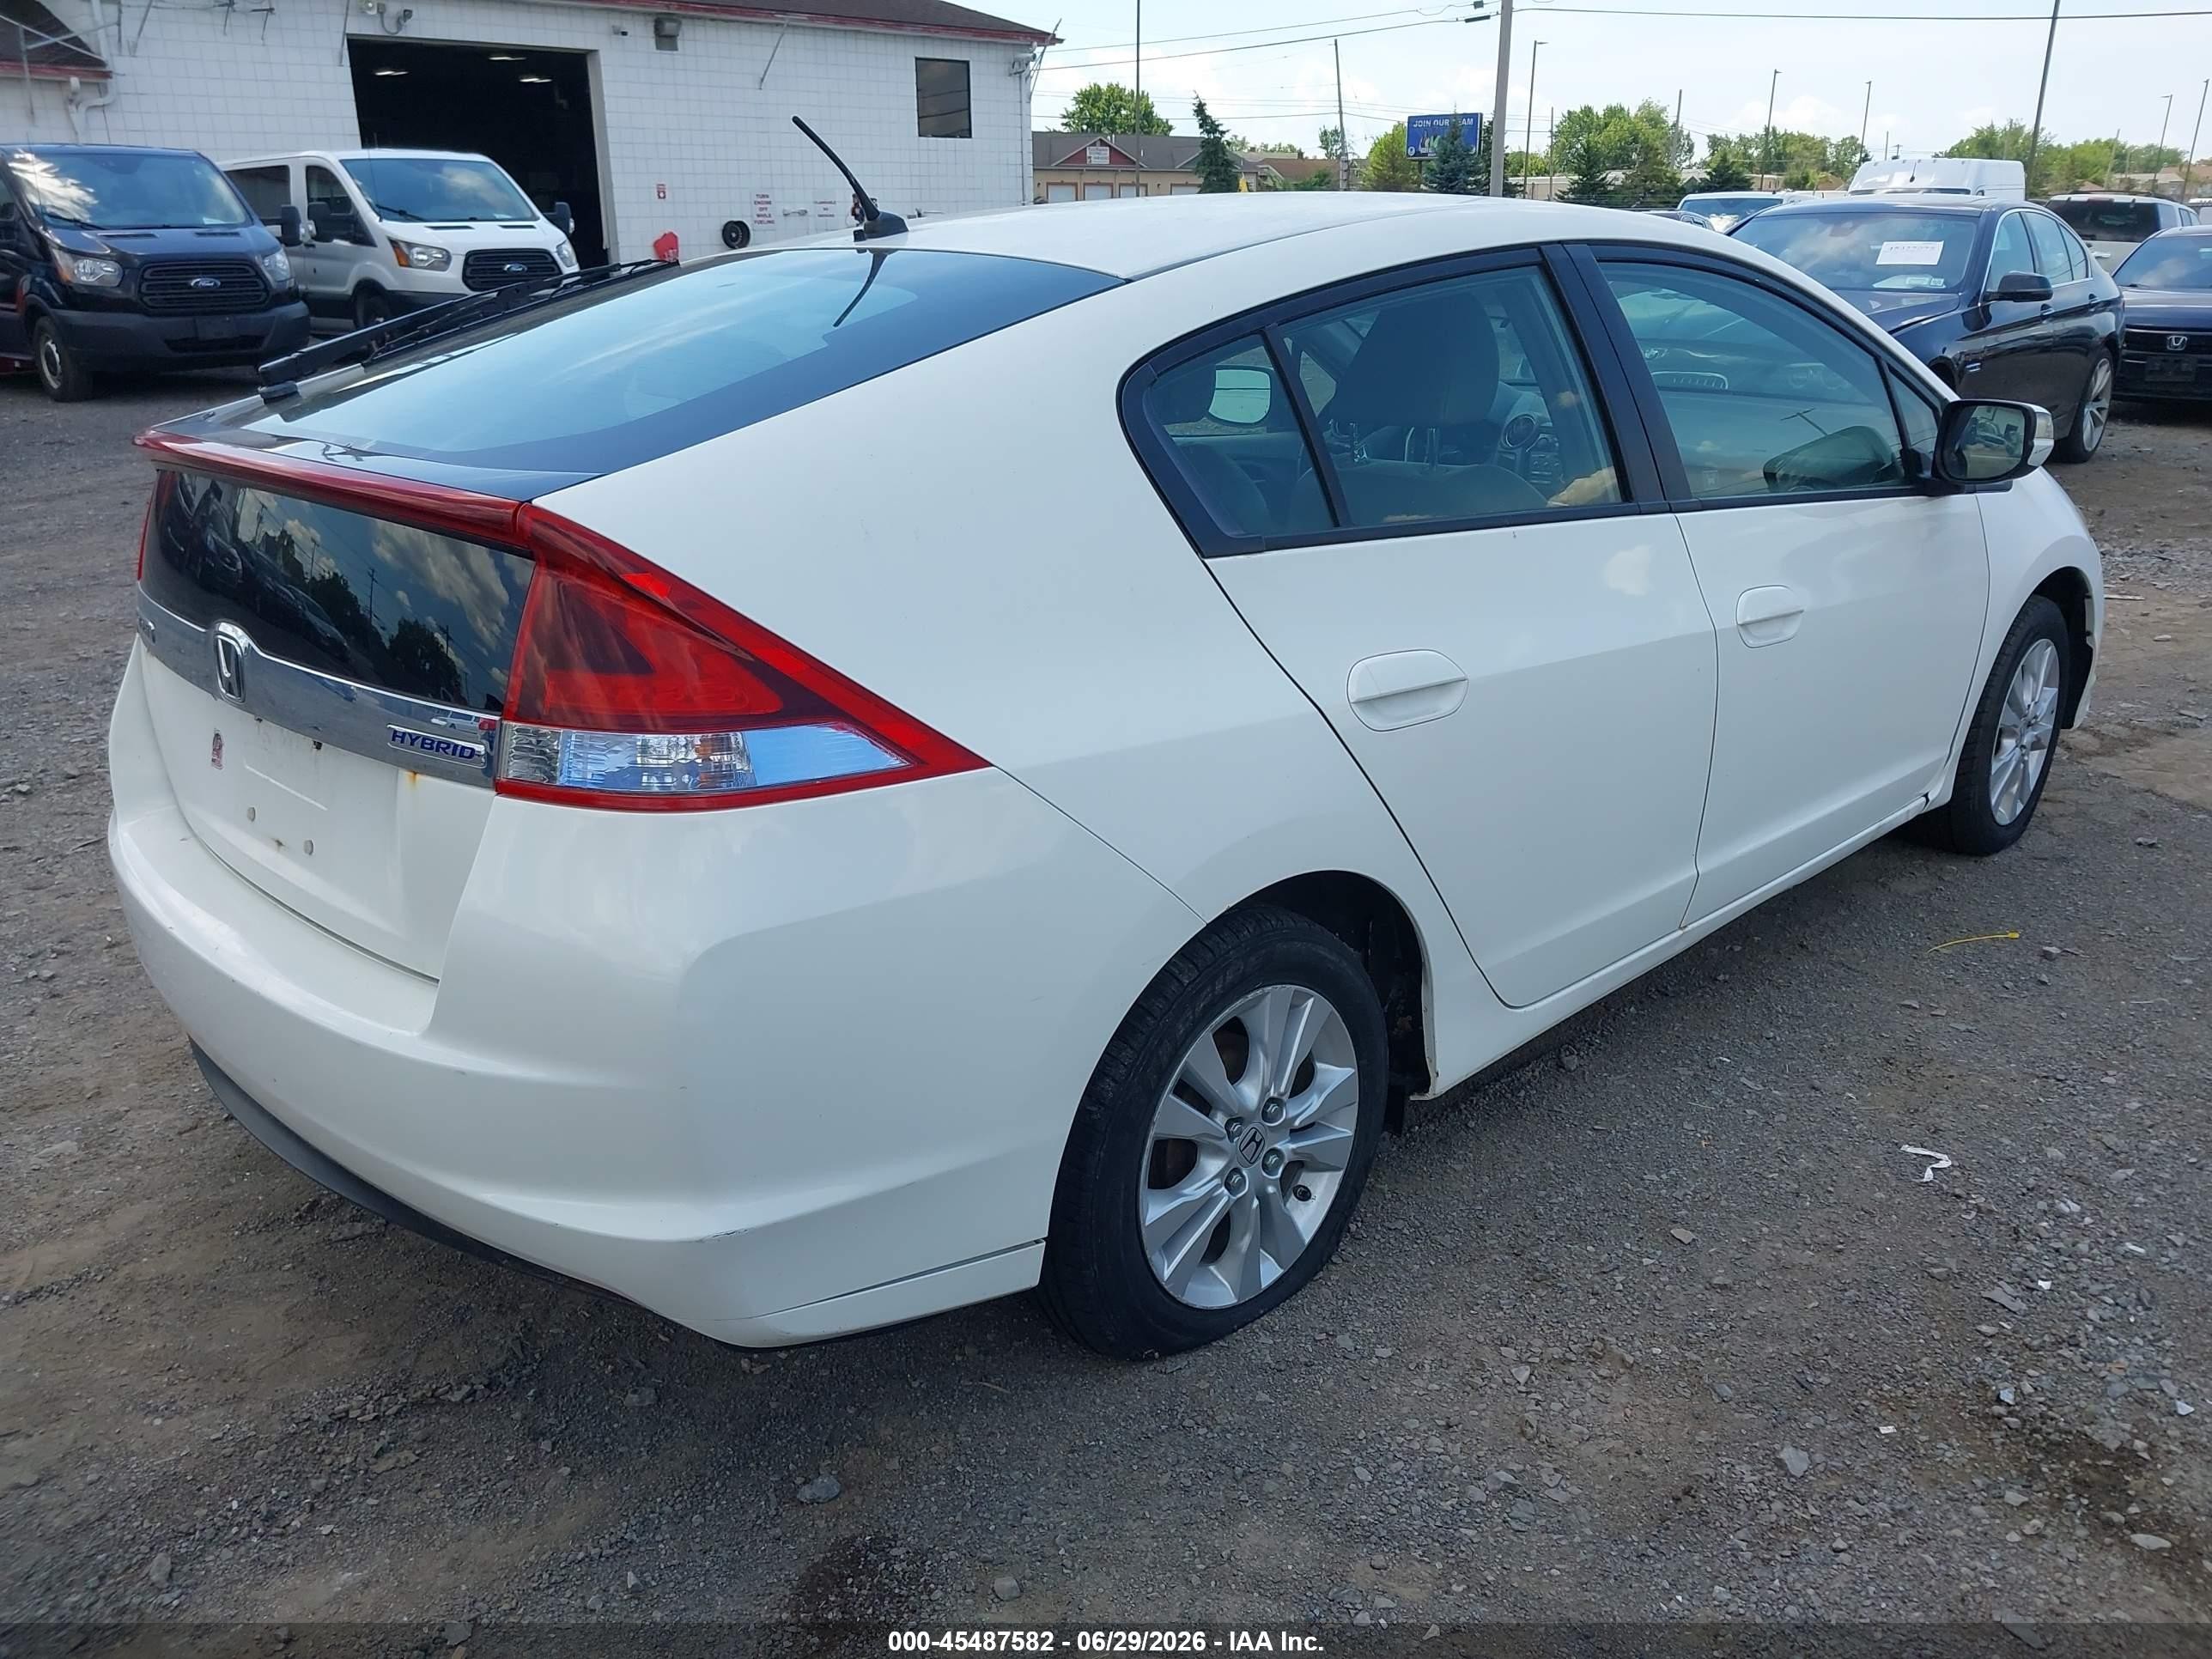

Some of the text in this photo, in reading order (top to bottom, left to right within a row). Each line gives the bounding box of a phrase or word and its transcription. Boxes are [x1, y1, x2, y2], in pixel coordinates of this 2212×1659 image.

[1413, 119, 1431, 128] JOIN
[1452, 117, 1474, 125] AM
[391, 729, 476, 760] HYBRID
